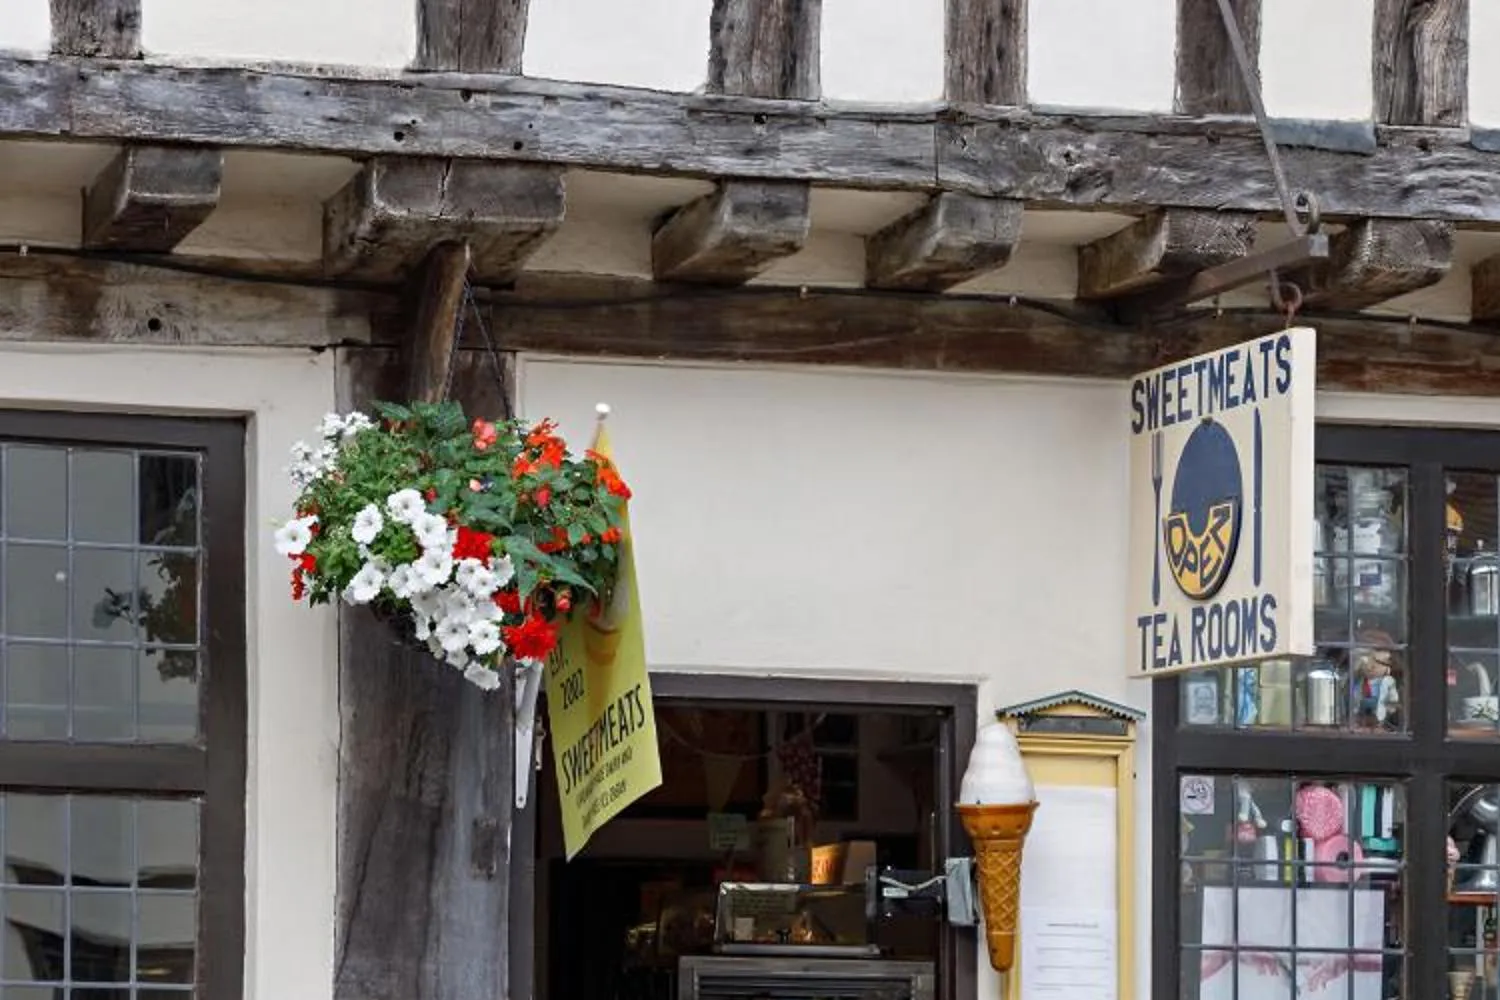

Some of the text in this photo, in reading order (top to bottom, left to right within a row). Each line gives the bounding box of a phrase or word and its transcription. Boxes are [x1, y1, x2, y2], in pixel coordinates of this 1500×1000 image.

[1131, 335, 1292, 434] SWEETMEATS
[1166, 503, 1233, 589] OPEN
[1137, 593, 1278, 671] TEA ROOMS
[561, 684, 645, 794] SWEETMEATS
